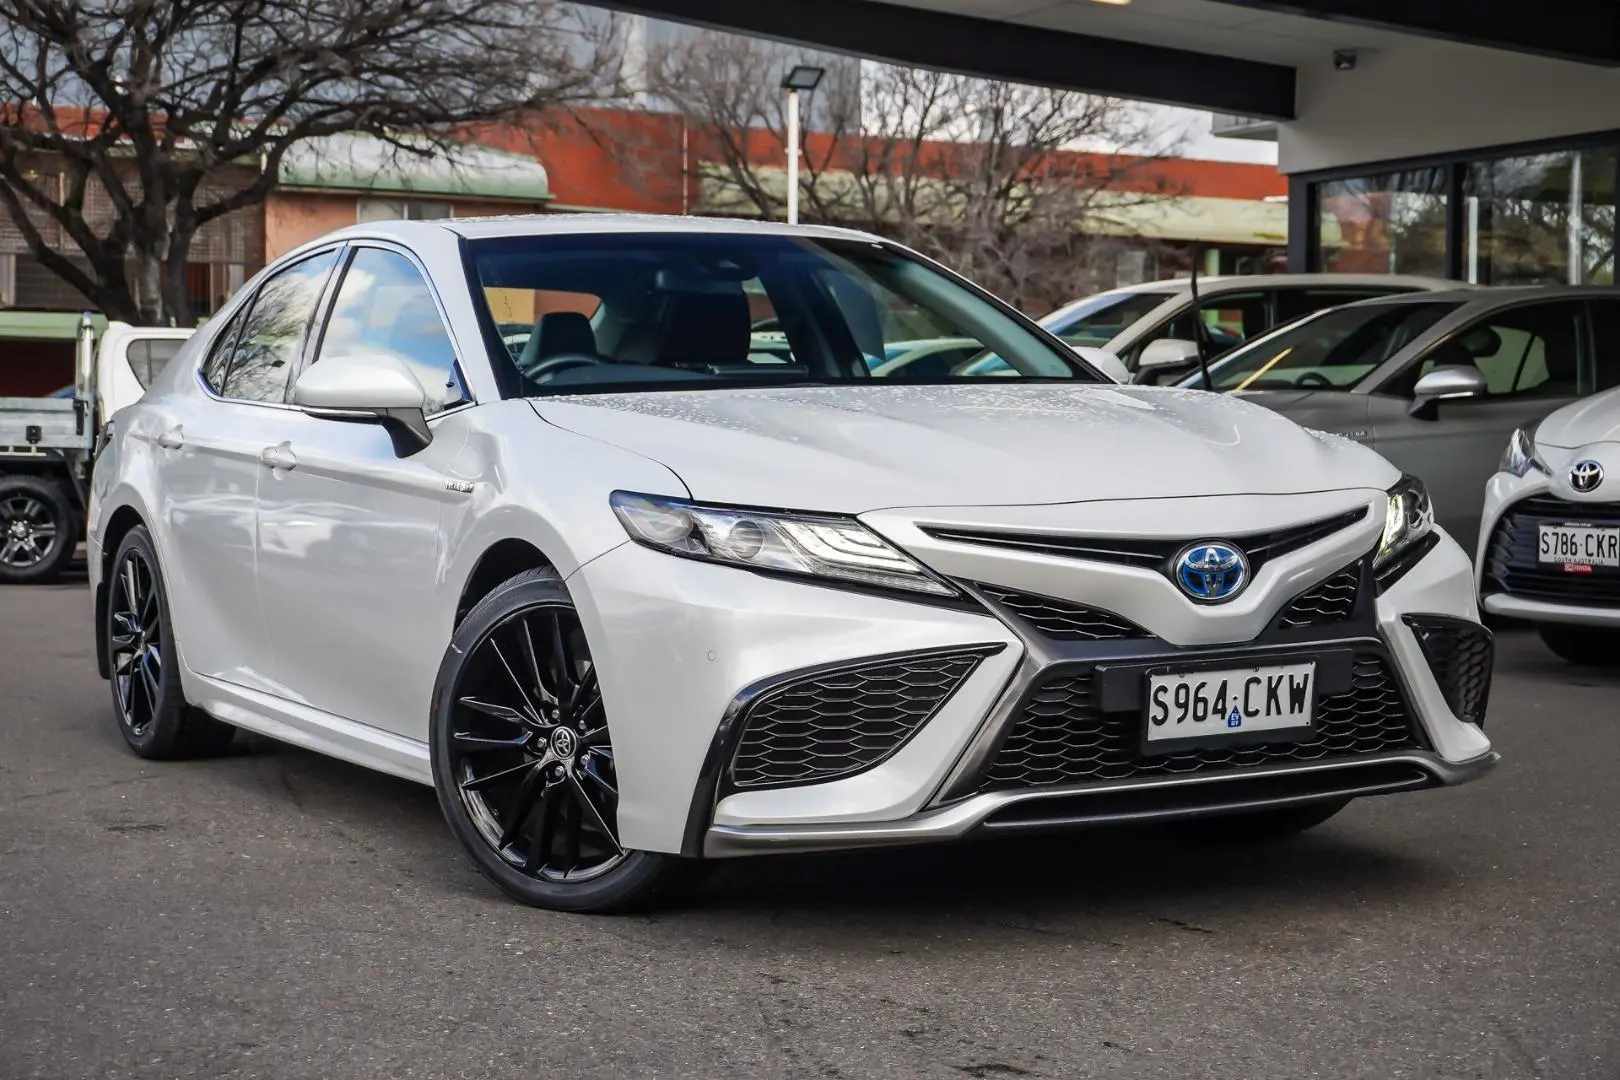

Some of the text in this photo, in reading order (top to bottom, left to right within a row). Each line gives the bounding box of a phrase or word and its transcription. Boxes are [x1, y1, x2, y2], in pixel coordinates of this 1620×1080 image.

[1541, 532, 1618, 559] S786 CKR
[1151, 673, 1309, 726] S964 CKW
